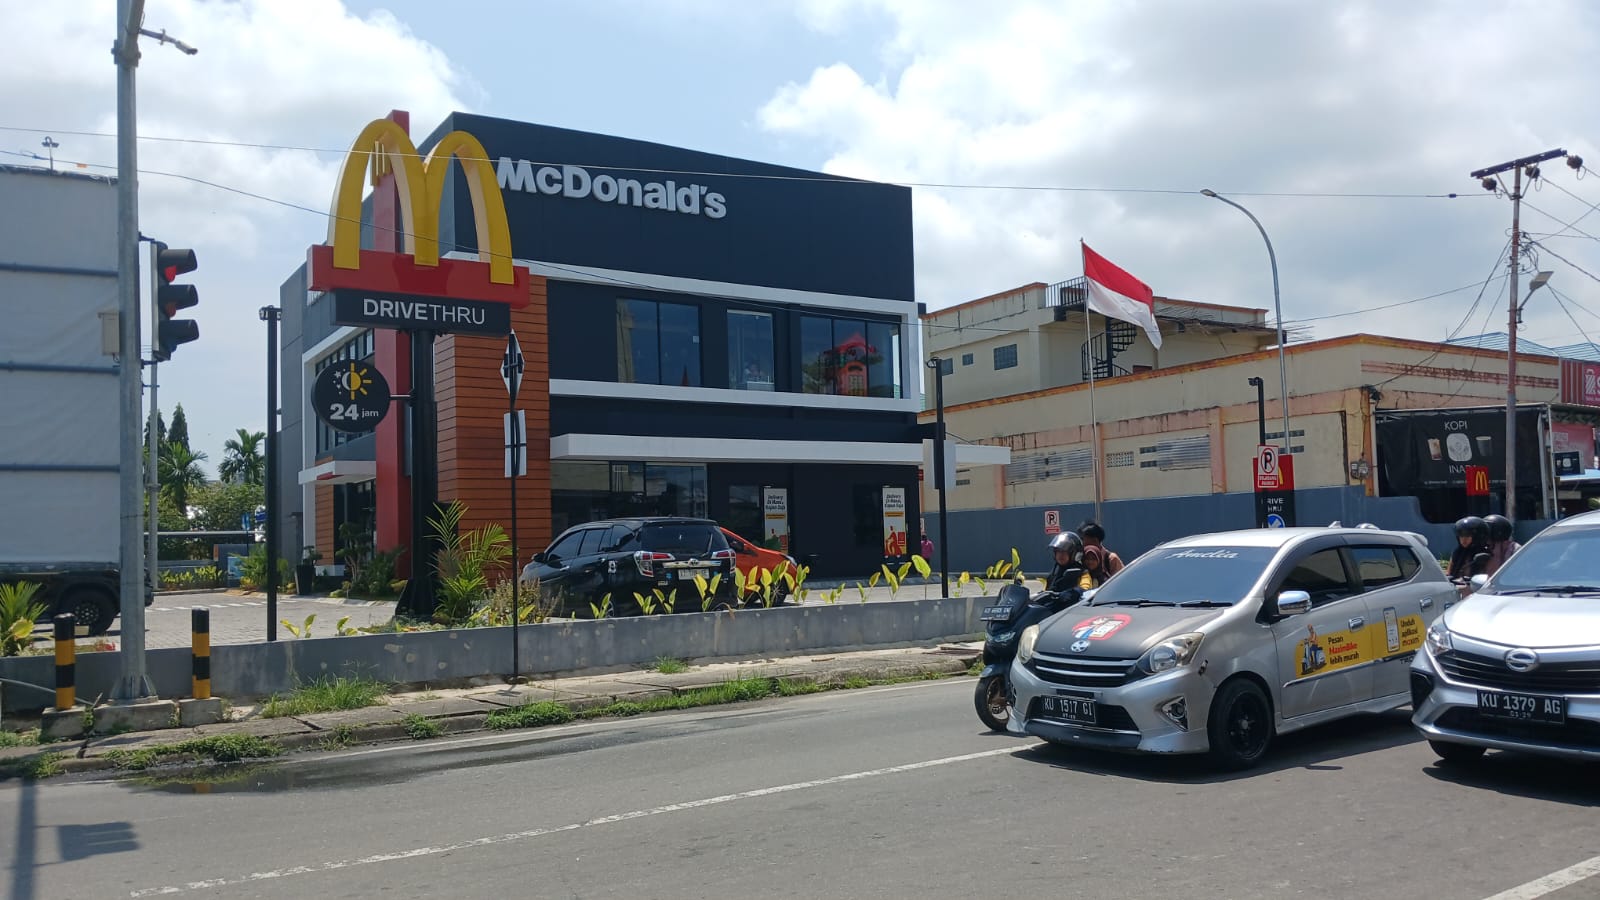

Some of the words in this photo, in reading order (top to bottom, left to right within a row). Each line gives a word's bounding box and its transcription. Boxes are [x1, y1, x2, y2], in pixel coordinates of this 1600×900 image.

[496, 156, 728, 219] McDonald's
[330, 403, 360, 421] 24
[361, 407, 379, 419] jam
[1444, 420, 1468, 431] KOPI
[1264, 451, 1273, 470] P
[1449, 465, 1477, 474] INA
[1164, 549, 1239, 559] Amelia
[1401, 617, 1416, 628] Unduh
[1402, 627, 1418, 637] aplikasi
[1328, 636, 1344, 645] Pesan
[1330, 655, 1343, 665] lebih
[1343, 650, 1360, 662] murah
[1044, 697, 1055, 711] KU
[1060, 699, 1078, 714] 1517
[1481, 693, 1498, 708] KU
[1503, 695, 1536, 712] 1379
[1544, 699, 1561, 714] AG
